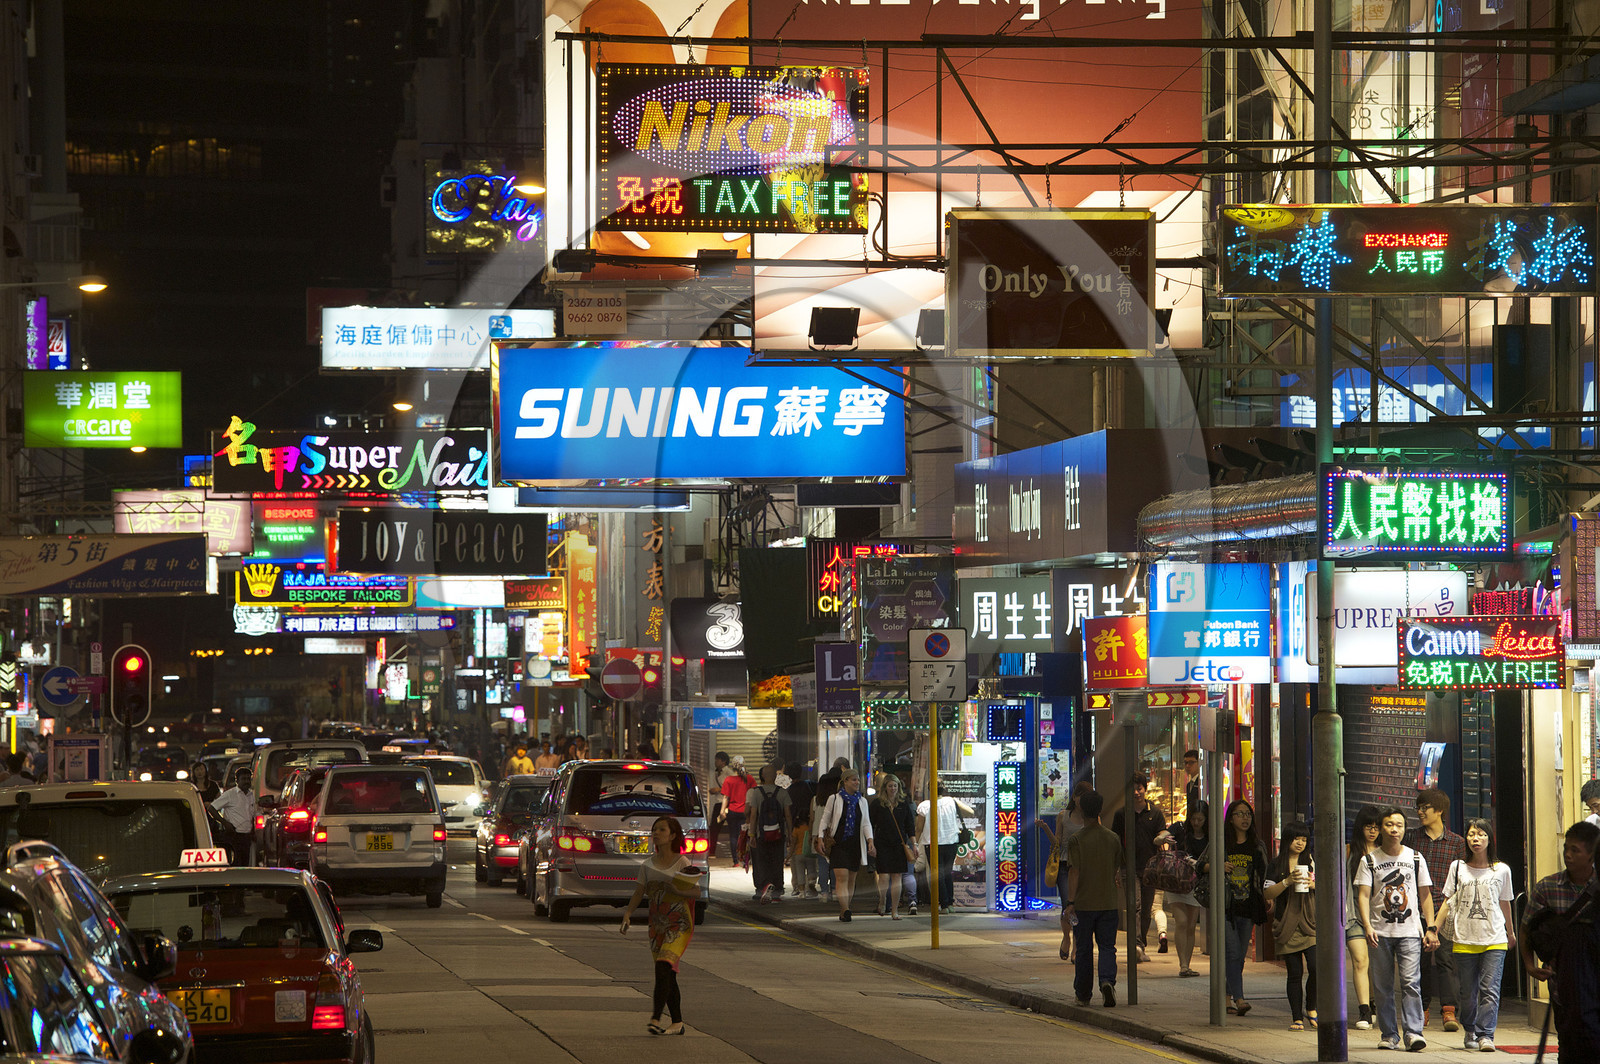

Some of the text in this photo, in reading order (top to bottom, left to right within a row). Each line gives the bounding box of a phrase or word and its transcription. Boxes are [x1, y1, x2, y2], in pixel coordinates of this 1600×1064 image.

[635, 100, 832, 152] Nikon
[693, 179, 760, 213] TAX
[771, 180, 850, 215] FREE
[1365, 233, 1449, 247] EXCHANGE
[978, 264, 1112, 298] Only You
[1116, 264, 1133, 316] 只有你
[567, 297, 622, 308] 2367 8105
[567, 313, 623, 323] 9662 0876
[335, 323, 481, 346] 海庭僱傭中心
[54, 380, 151, 410] 華潤堂
[514, 384, 890, 439] SUNING 蘇寧
[63, 419, 132, 435] CRcare
[214, 415, 489, 491] 名甲 Super Nail
[264, 508, 315, 519] BESPOKE
[1333, 481, 1502, 544] 人民幣找換
[37, 541, 110, 566] 第5街
[414, 528, 426, 562] &
[67, 578, 204, 591] Fashion Wigs & Hairpieces
[506, 582, 563, 600] Super Nail
[289, 590, 402, 601] BESPOKE TAILORS
[879, 605, 907, 619] 染髮
[971, 590, 1052, 640] 周生生
[1335, 607, 1427, 629] UPRE
[706, 602, 745, 650] 3
[882, 623, 904, 631] Color
[1203, 620, 1259, 629] Fubon Bank
[1183, 630, 1260, 648] 富邦銀行
[1405, 621, 1557, 658] Canon Leica
[946, 664, 956, 678] 7
[1093, 667, 1147, 677] HUI LA
[1455, 661, 1498, 684] TAX
[1502, 660, 1558, 683] FREE
[946, 685, 956, 699] 7
[367, 842, 393, 850] 7895
[373, 835, 386, 843] MF
[185, 851, 222, 863] TAXI
[184, 990, 213, 1007] KL
[178, 1006, 228, 1022] 540
